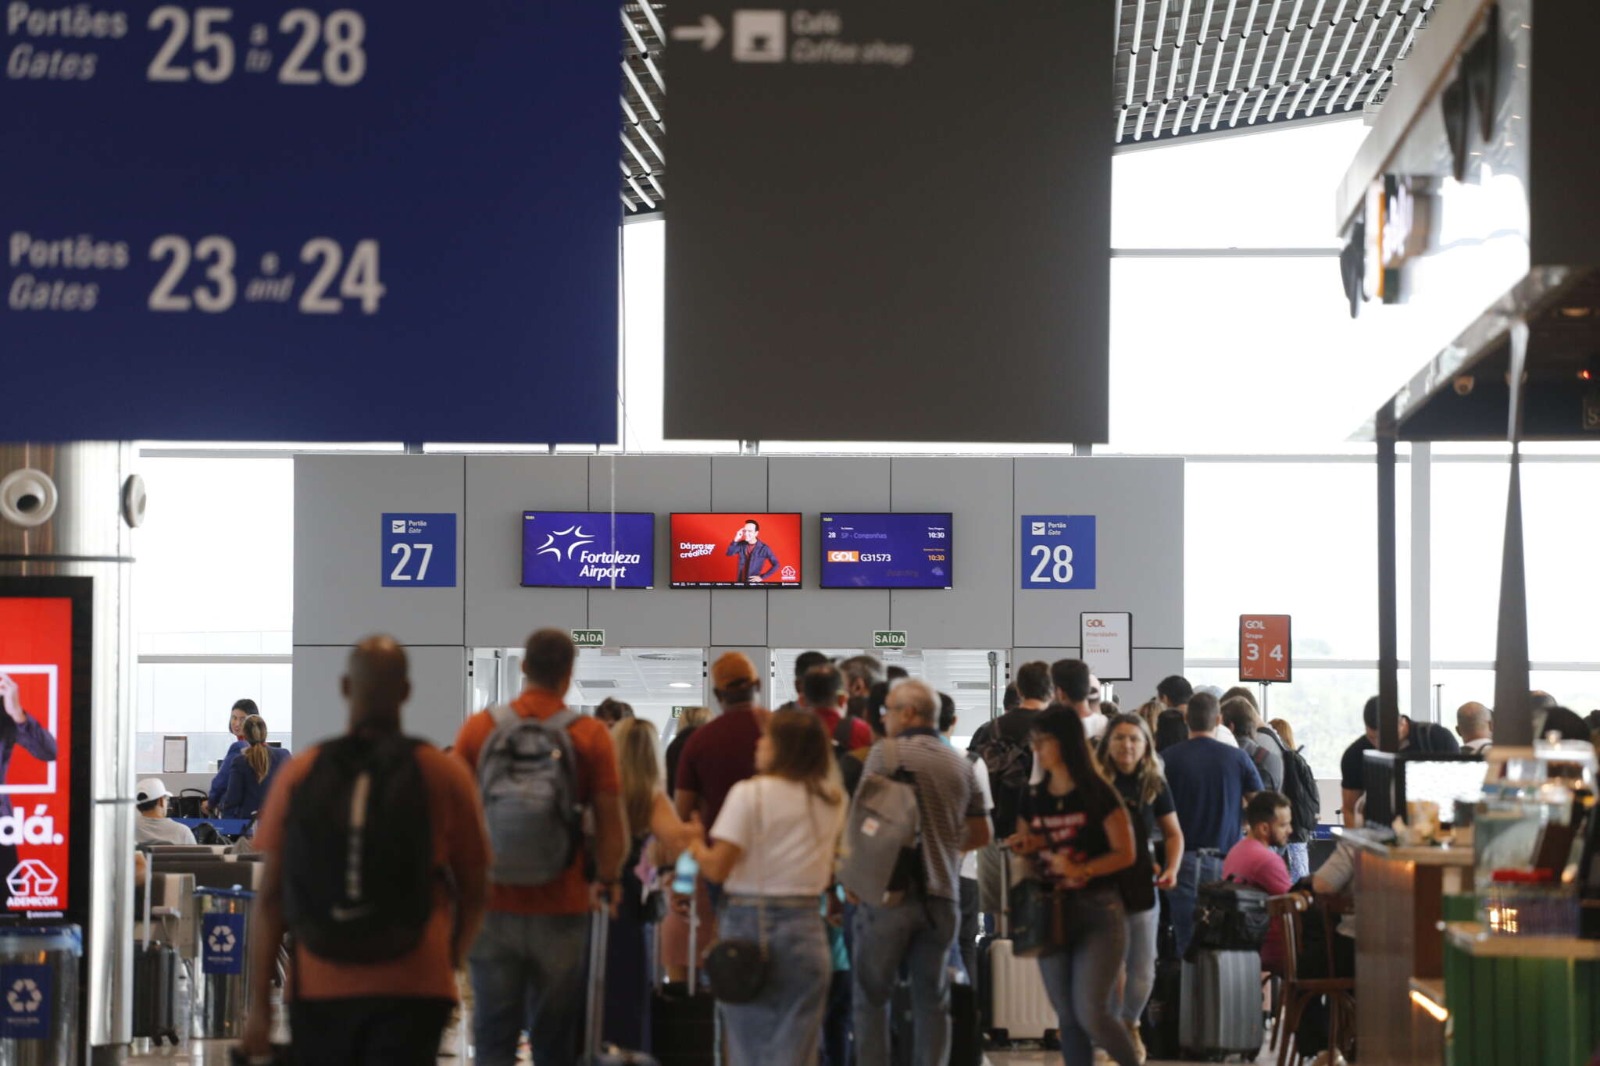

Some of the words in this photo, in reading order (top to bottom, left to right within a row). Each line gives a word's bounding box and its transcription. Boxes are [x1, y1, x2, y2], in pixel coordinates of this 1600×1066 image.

[7, 1, 128, 39] Portões
[147, 6, 235, 83] 25
[278, 9, 366, 86] 28
[6, 44, 96, 80] Gates
[9, 231, 129, 269] Portões
[149, 235, 236, 313] 23
[299, 238, 385, 314] 24
[8, 274, 98, 311] Gates
[245, 274, 294, 301] and
[580, 550, 640, 564] Fortaleza
[680, 542, 691, 550] Dá
[680, 549, 713, 559] crédito?
[831, 551, 856, 562] GOL
[860, 553, 892, 562] G31573
[391, 543, 433, 580] 27
[579, 564, 627, 581] Airport
[1030, 544, 1073, 583] 28
[1087, 619, 1105, 628] GOL
[1245, 620, 1266, 630] GOL
[572, 631, 603, 643] SAÍDA
[875, 632, 905, 644] SAÍDA
[1246, 643, 1260, 661] 3
[1269, 644, 1284, 662] 4
[0, 803, 64, 846] dá.
